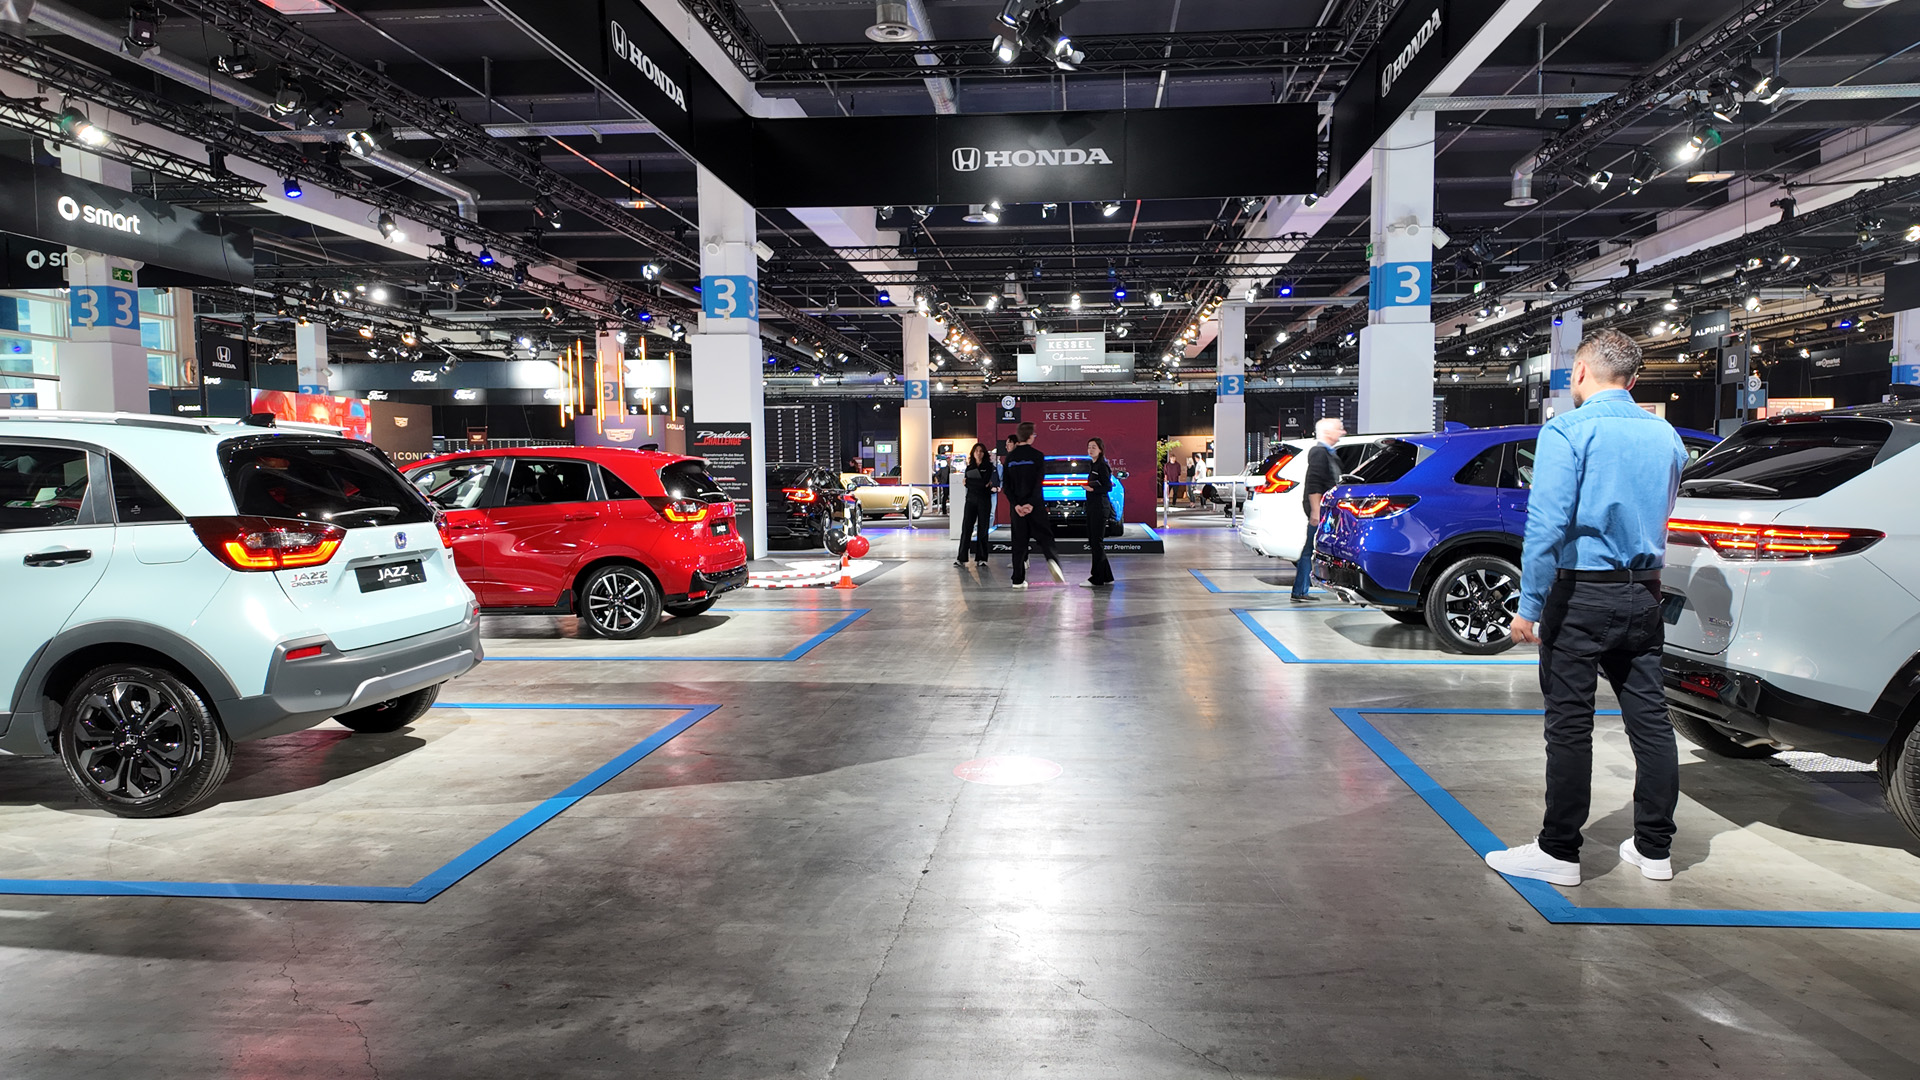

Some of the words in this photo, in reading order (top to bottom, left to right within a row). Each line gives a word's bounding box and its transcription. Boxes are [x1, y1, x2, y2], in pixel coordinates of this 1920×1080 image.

[1392, 8, 1442, 82] HONDA
[628, 39, 688, 113] HONDA
[985, 147, 1113, 168] HONDA
[82, 203, 141, 235] smart
[1395, 265, 1421, 304] 3
[714, 278, 737, 316] 3
[748, 281, 757, 318] 3
[77, 288, 100, 324] 3
[114, 290, 133, 326] 3
[1694, 323, 1726, 337] ALPINE
[1048, 340, 1093, 349] KESSEL
[211, 361, 237, 370] HONDA
[203, 375, 222, 385] ord
[411, 369, 438, 382] Ford
[603, 382, 615, 400] 3
[911, 381, 924, 399] 3
[1227, 376, 1240, 394] 3
[367, 390, 389, 400] Ford
[453, 389, 477, 400] Ford
[1045, 412, 1088, 420] KESSEL
[696, 430, 749, 439] Prelude
[703, 437, 742, 446] CHALLENGE
[290, 570, 328, 583] JAZZ
[377, 565, 410, 581] JAZZ
